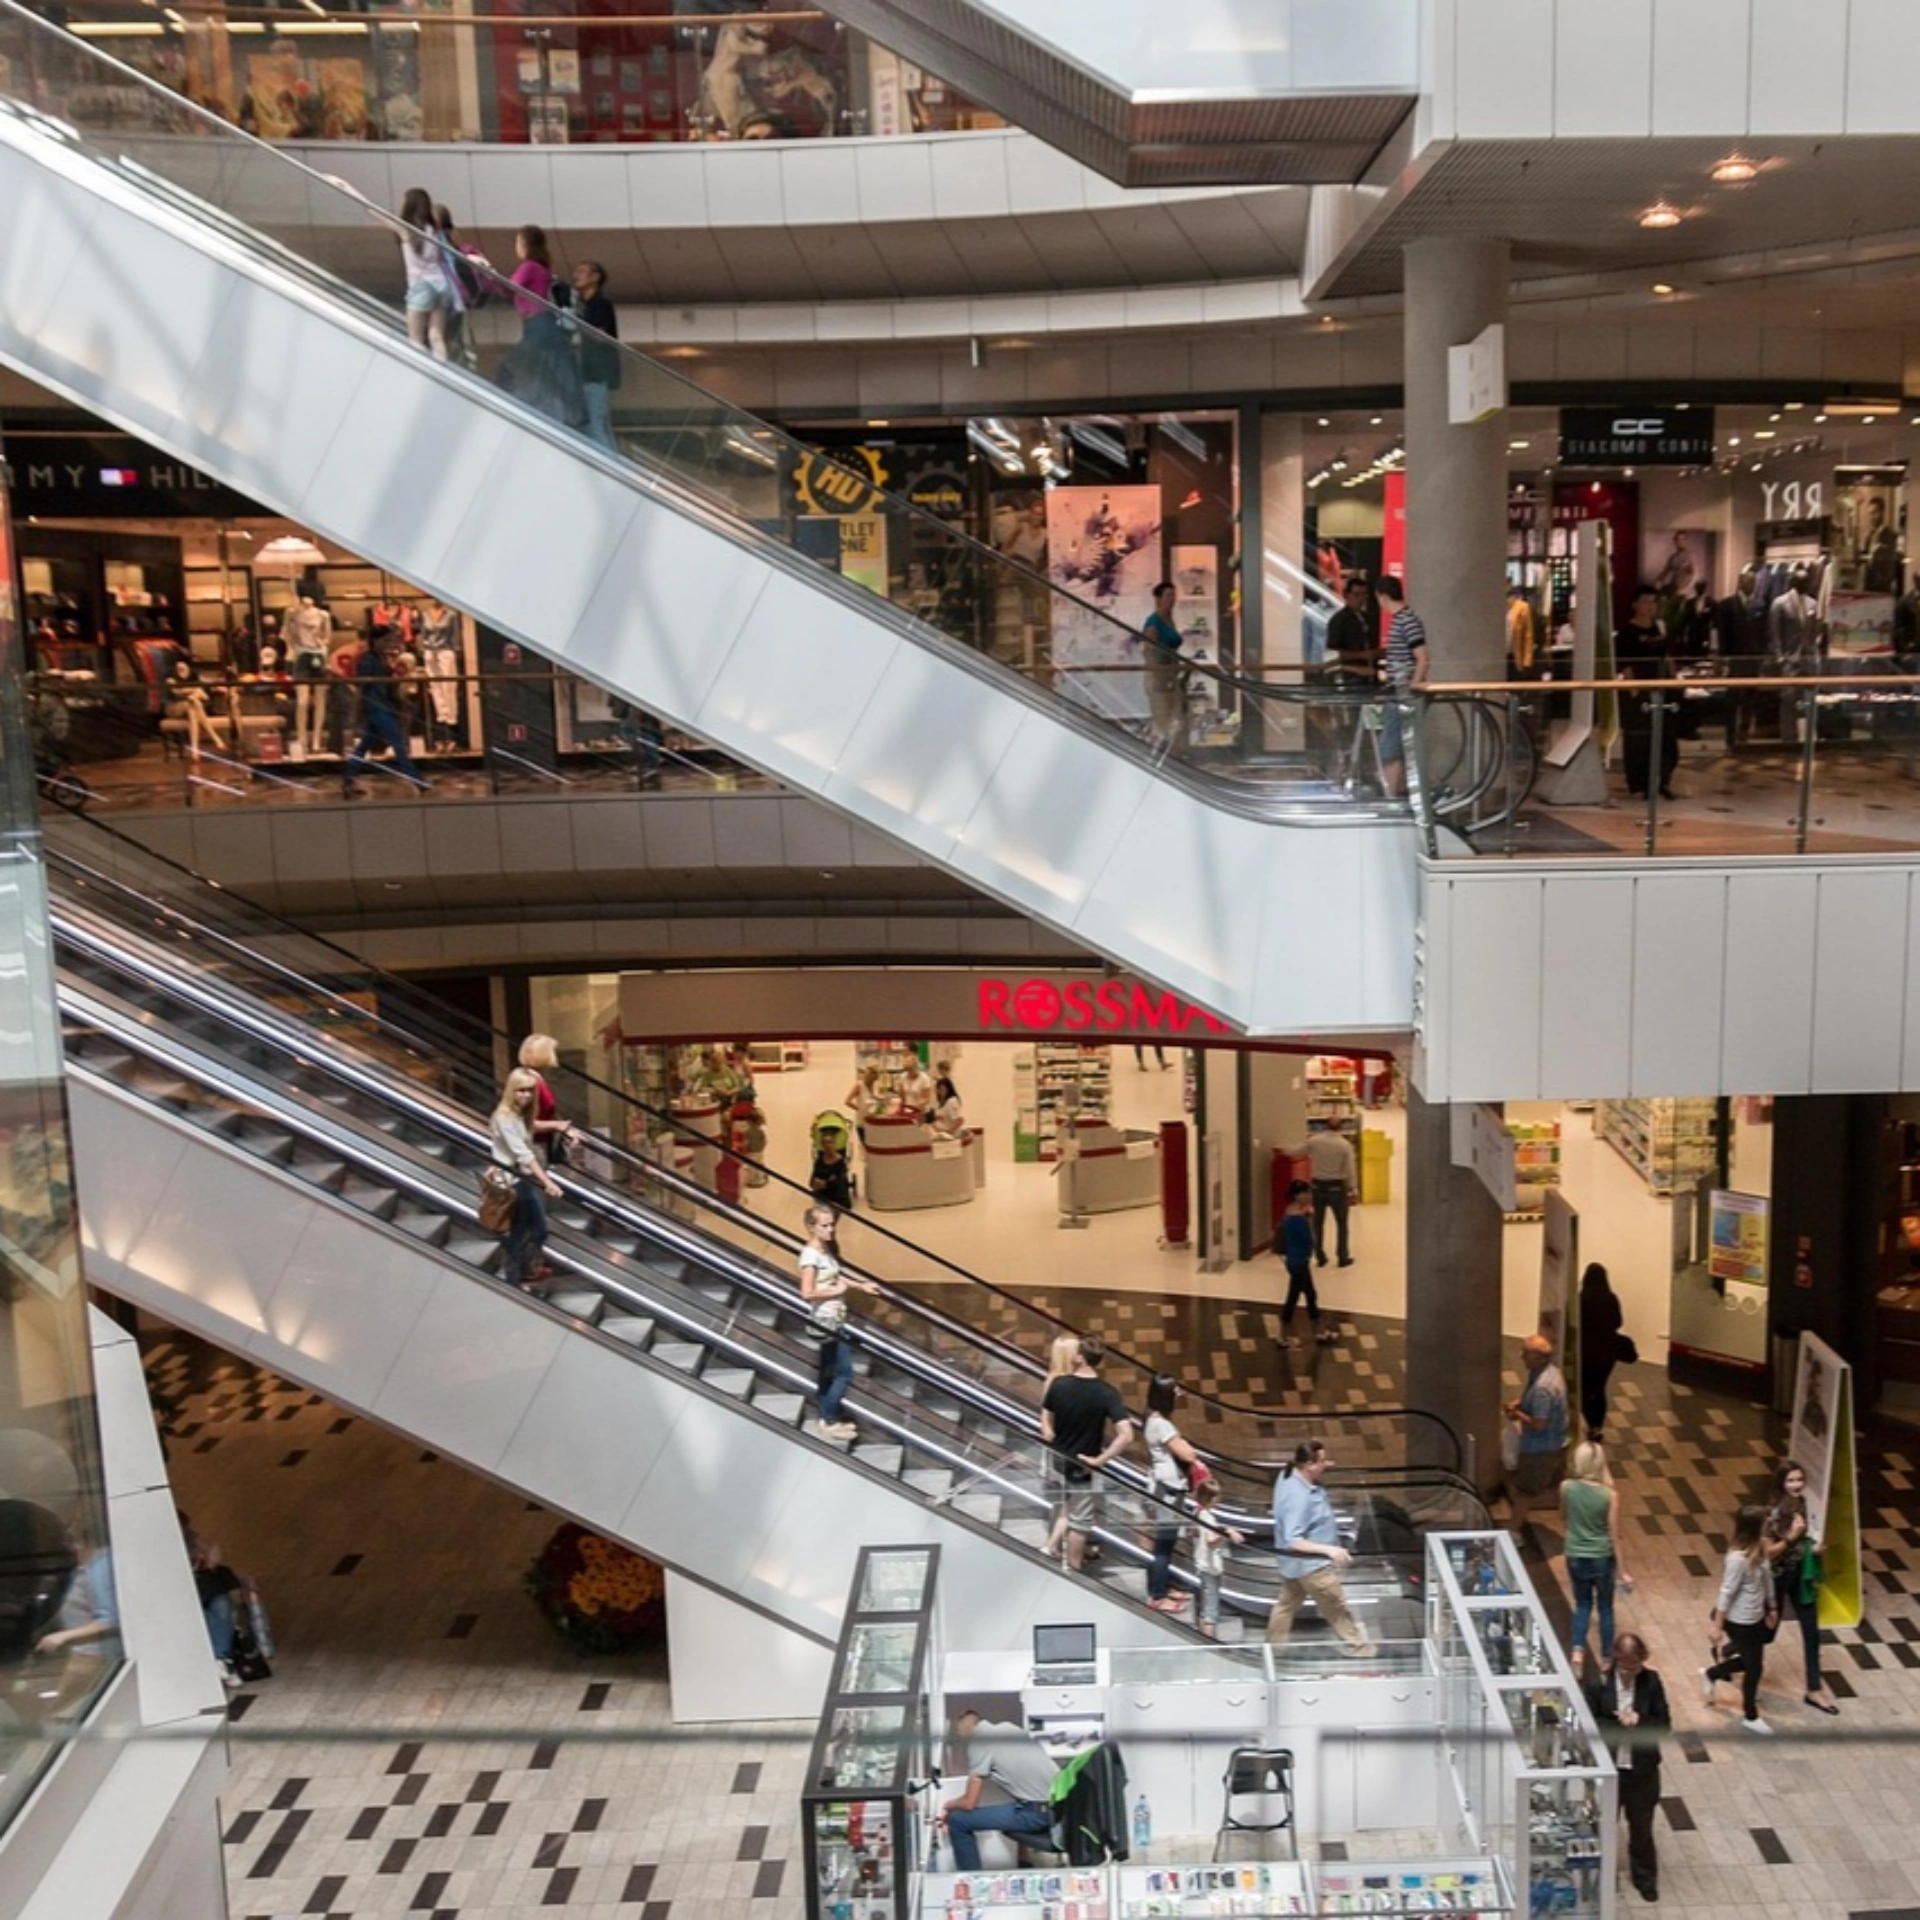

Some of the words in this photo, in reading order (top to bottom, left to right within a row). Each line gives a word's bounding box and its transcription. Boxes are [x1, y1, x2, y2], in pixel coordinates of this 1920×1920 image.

[152, 465, 222, 488] HIL
[841, 522, 875, 536] TLET
[978, 979, 1230, 1034] ROSSMA
